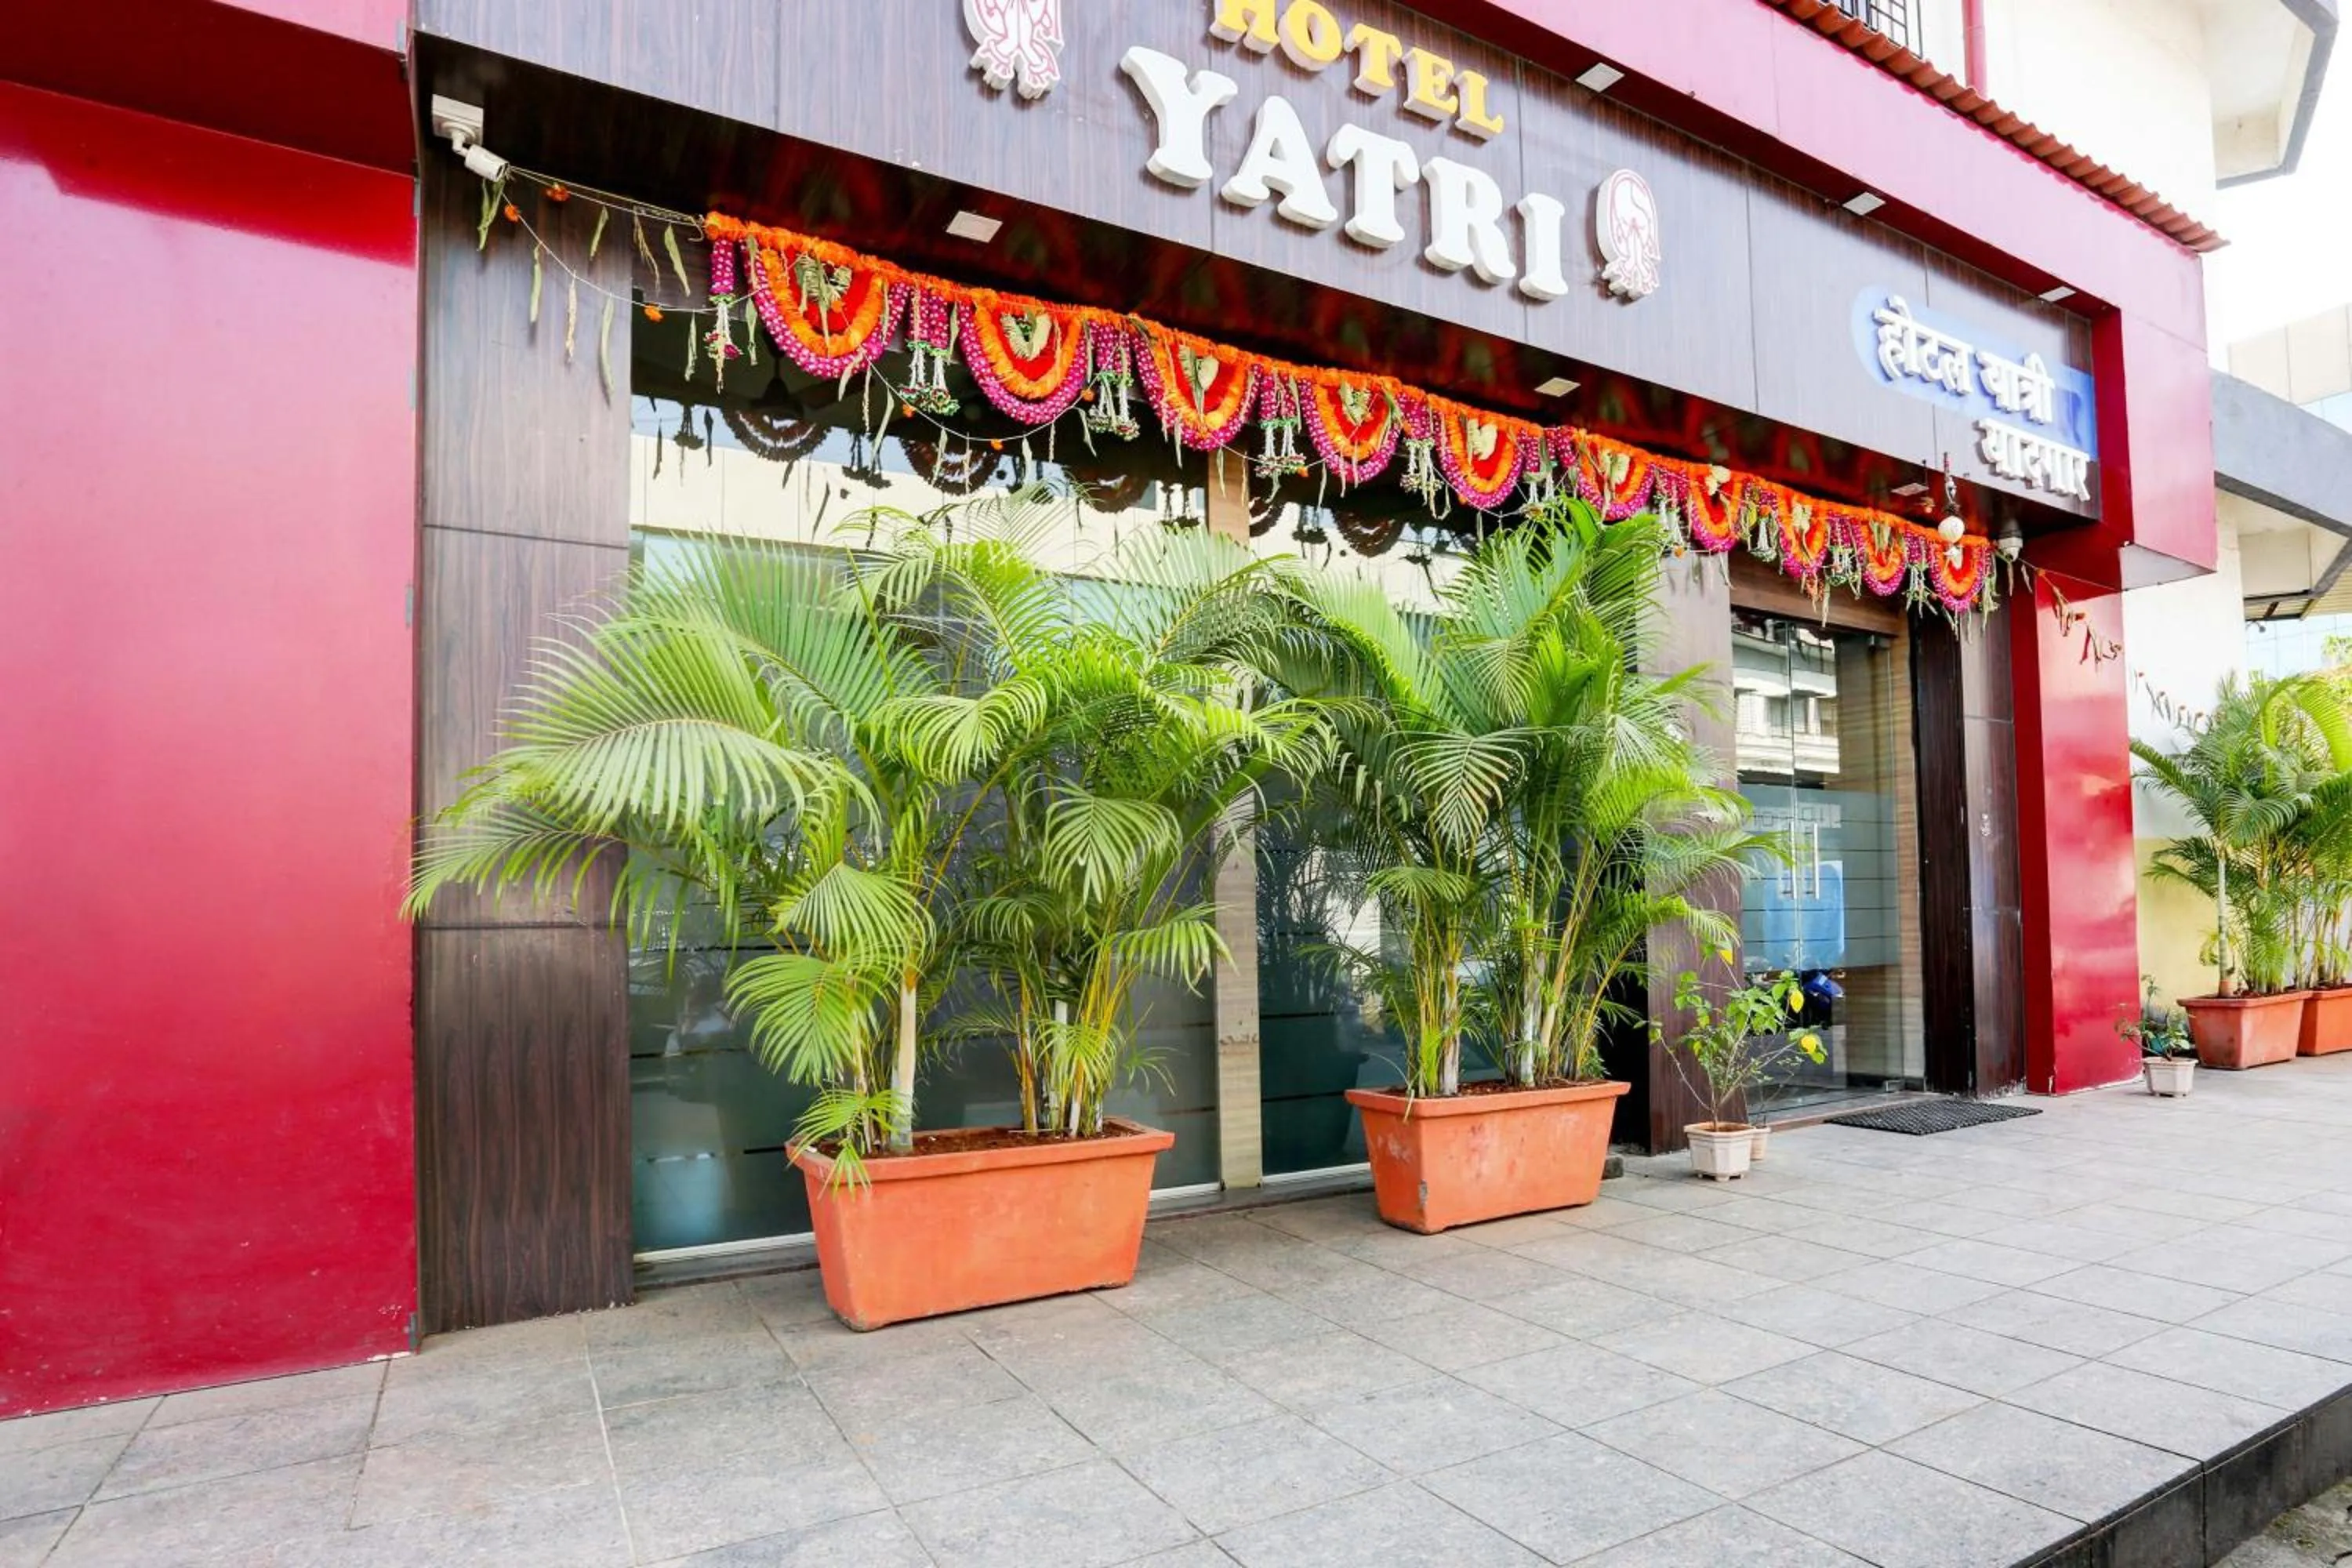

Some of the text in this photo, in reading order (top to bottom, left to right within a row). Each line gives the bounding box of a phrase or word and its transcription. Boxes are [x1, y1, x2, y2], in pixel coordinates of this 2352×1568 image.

[1210, 0, 1504, 140] HOTEL
[1120, 45, 1568, 300] YATRI
[1874, 295, 2055, 423] होटल यात्री
